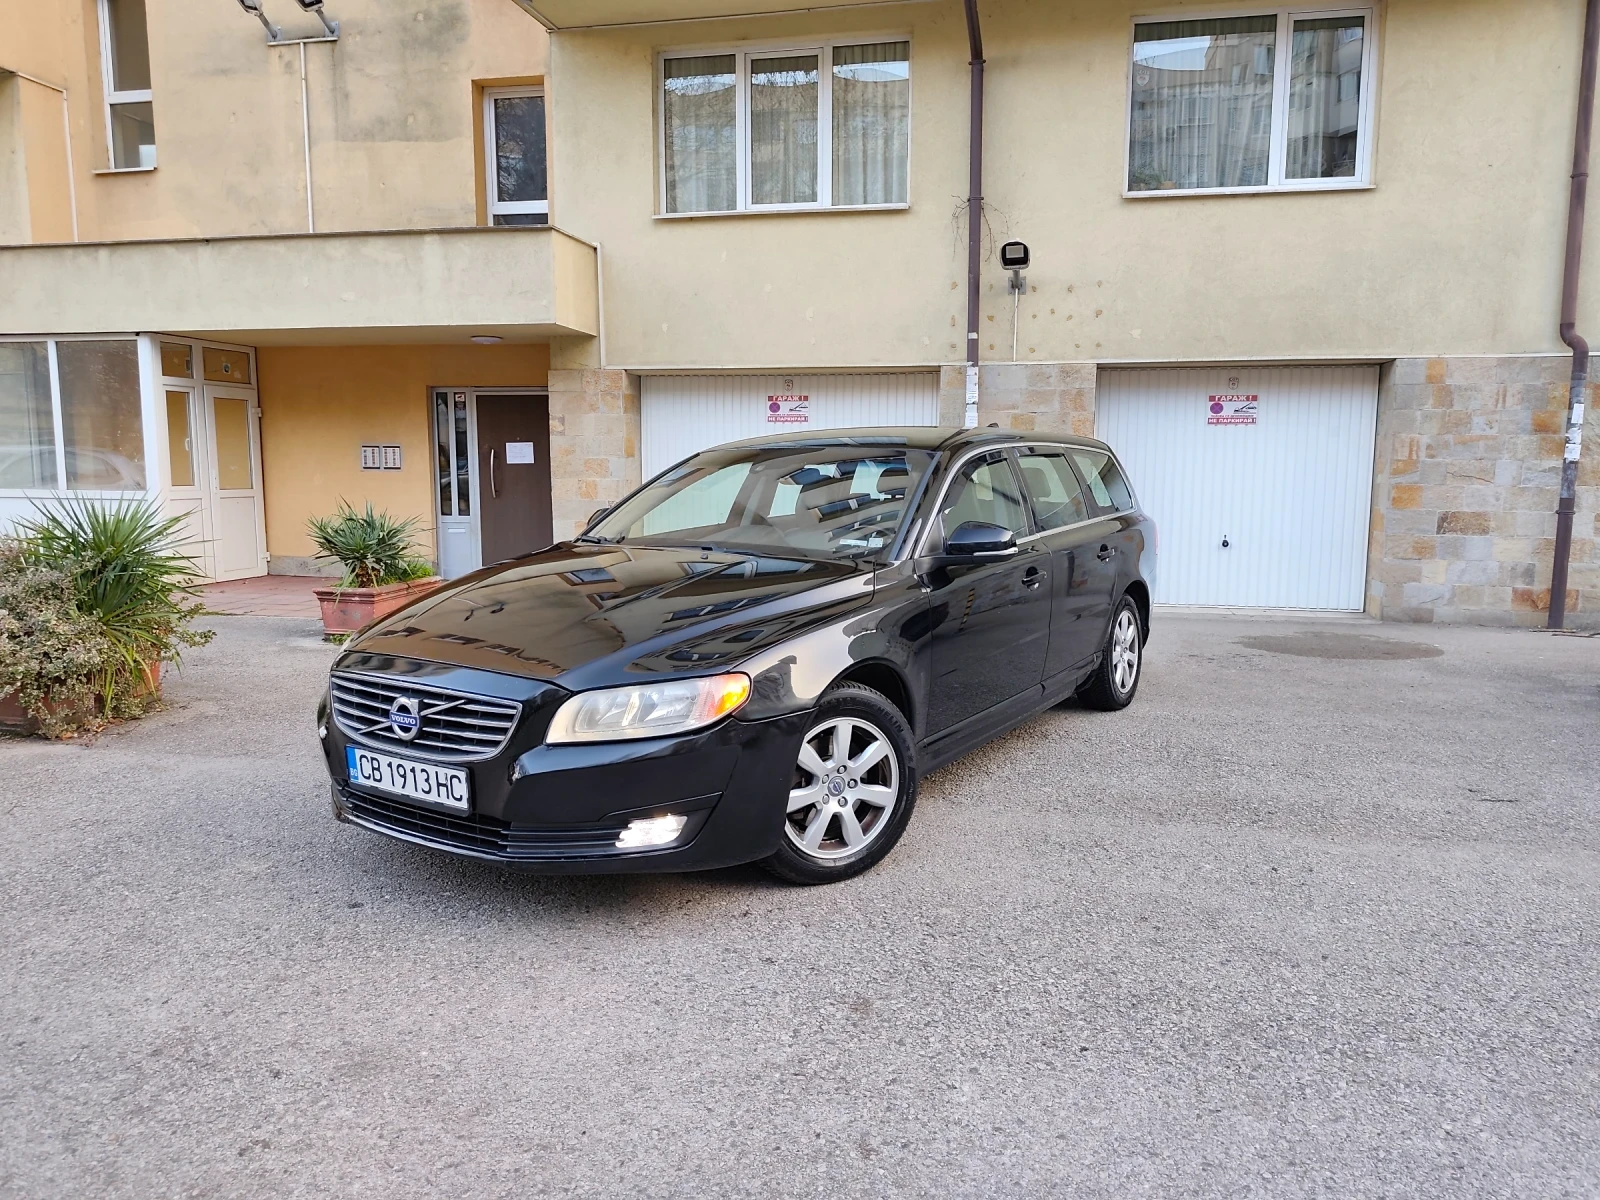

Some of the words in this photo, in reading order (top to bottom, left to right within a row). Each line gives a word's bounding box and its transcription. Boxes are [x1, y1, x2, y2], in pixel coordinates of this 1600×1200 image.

[391, 714, 416, 724] VOLVO
[350, 767, 358, 777] BG
[359, 754, 383, 783] CB
[387, 761, 432, 795] 1913
[435, 770, 463, 802] HC
